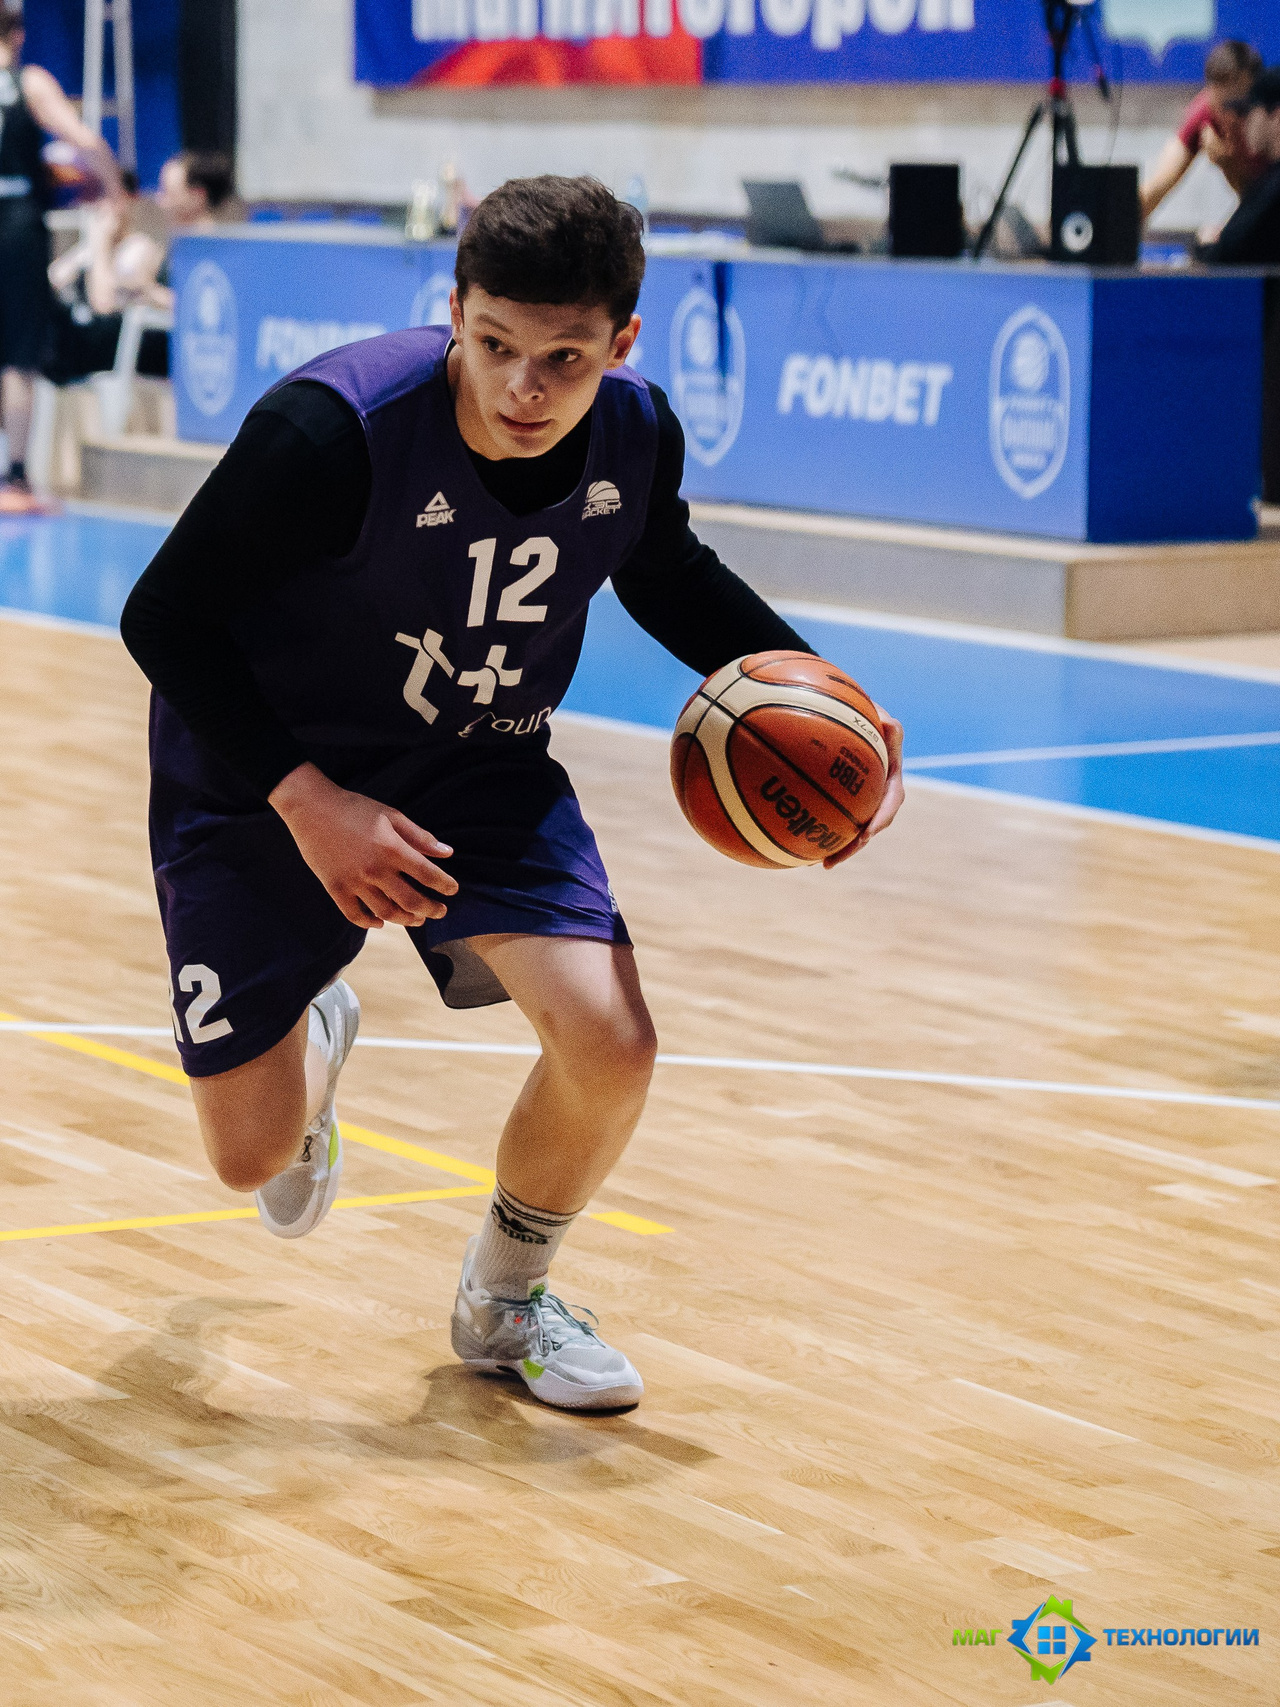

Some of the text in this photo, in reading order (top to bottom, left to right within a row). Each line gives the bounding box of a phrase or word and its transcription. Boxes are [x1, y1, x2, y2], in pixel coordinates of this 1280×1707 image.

[777, 352, 956, 427] FONBET
[416, 508, 457, 528] PEAK
[466, 536, 560, 628] 12
[760, 775, 846, 852] molten
[828, 755, 867, 798] FIBA
